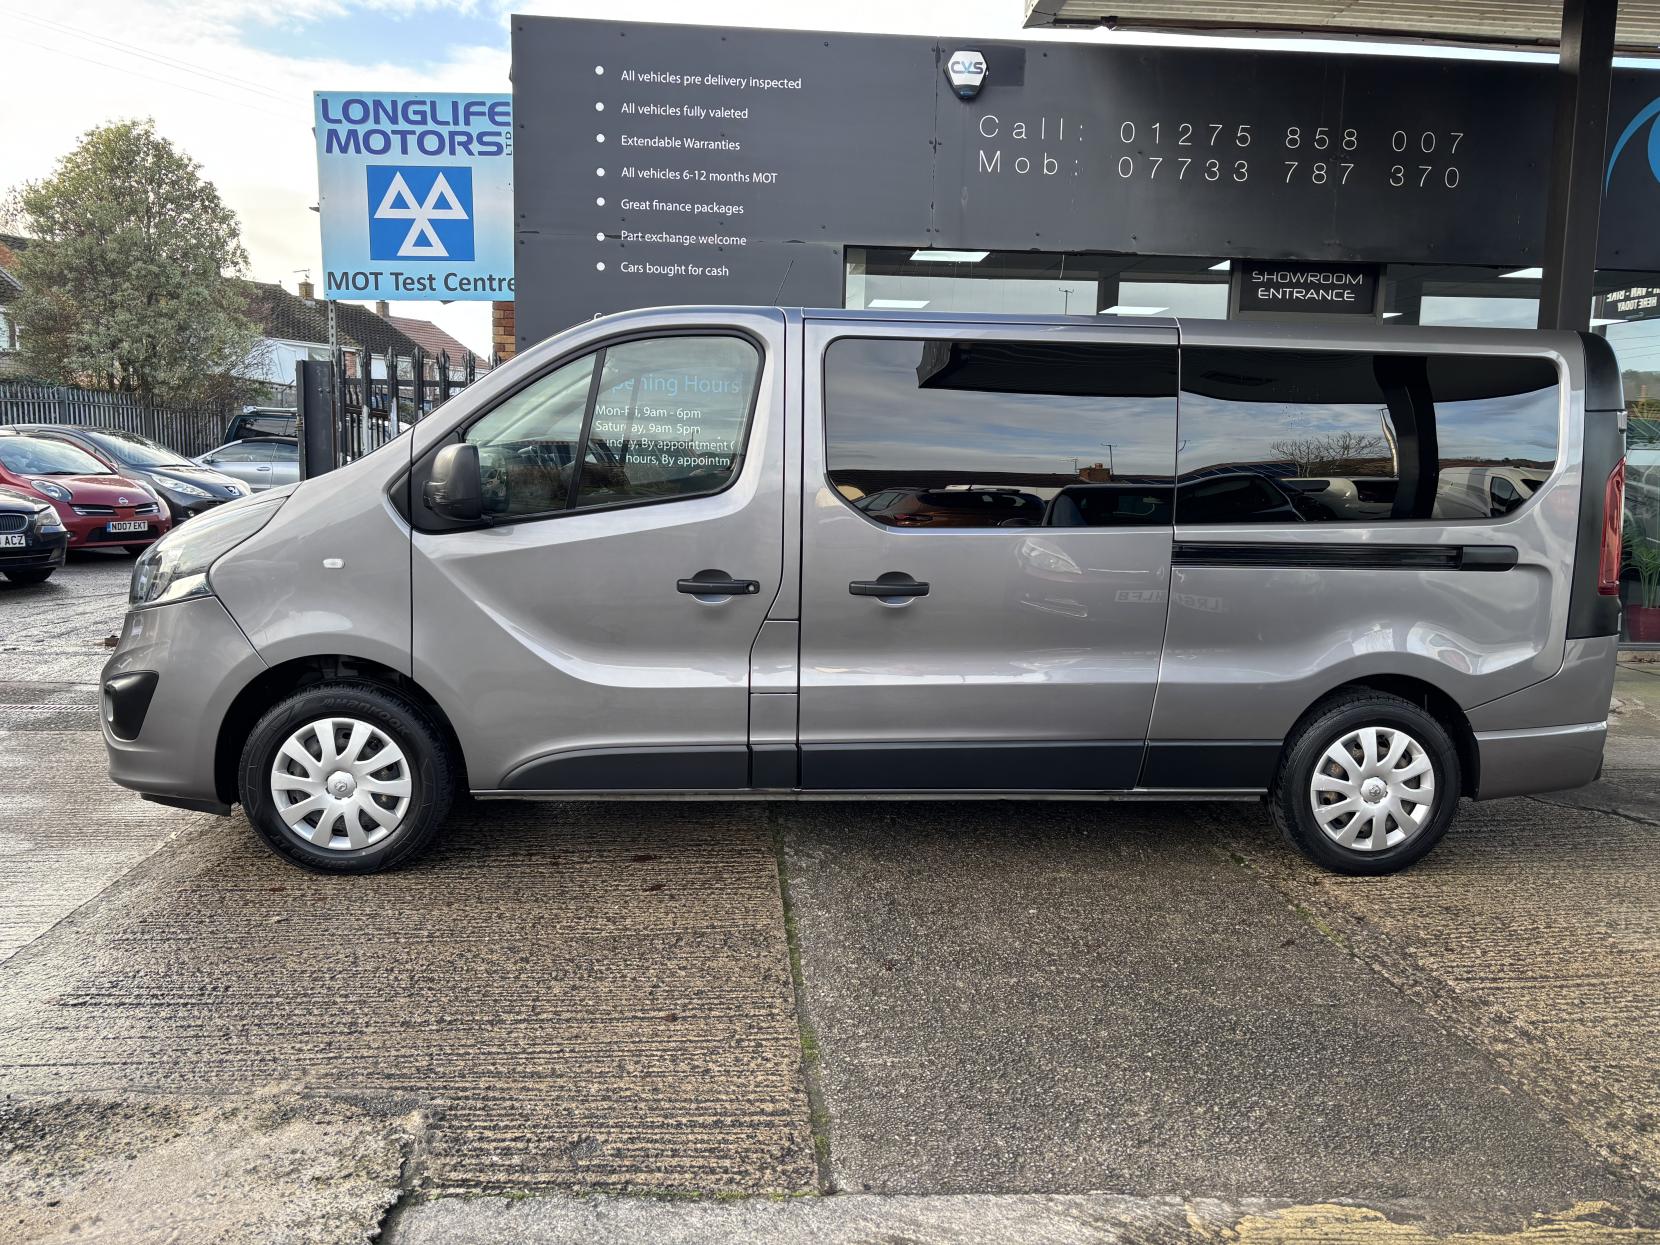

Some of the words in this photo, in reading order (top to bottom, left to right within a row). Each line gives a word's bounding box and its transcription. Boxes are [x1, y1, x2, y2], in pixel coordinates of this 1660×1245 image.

[951, 61, 983, 74] CVS
[621, 70, 635, 81] All
[638, 72, 681, 84] vehicles
[684, 75, 702, 86] pre
[704, 75, 747, 88] delivery
[750, 77, 802, 90] inspected
[321, 98, 512, 127] LONGLIFE
[621, 103, 635, 114] All
[638, 104, 681, 116] vehicles
[683, 105, 706, 119] fully
[709, 107, 748, 119] valeted
[979, 115, 1083, 142] Call:
[1120, 121, 1251, 147] 01275
[1285, 127, 1357, 150] 858
[1392, 131, 1464, 154] 007
[325, 128, 504, 157] MOTORS
[621, 135, 681, 148] Extendable
[683, 137, 741, 150] Warranties
[621, 167, 635, 178] All
[638, 168, 680, 180] vehicles
[683, 170, 707, 181] 6-12
[710, 171, 750, 182] months
[753, 172, 778, 184] MOT
[979, 150, 1078, 176] Mob:
[1118, 157, 1248, 182] 07733
[1284, 161, 1354, 185] 787
[1390, 165, 1460, 188] 370
[621, 199, 650, 210] Great
[652, 200, 692, 212] finance
[694, 201, 744, 216] packages
[621, 230, 643, 241] Part
[645, 231, 696, 246] exchange
[698, 234, 747, 245] welcome
[621, 262, 644, 273] Cars
[647, 263, 685, 277] bought
[688, 264, 703, 275] for
[705, 265, 729, 276] cash
[327, 271, 383, 290] MOT
[390, 272, 436, 291] Test
[444, 273, 514, 292] Centre
[1252, 271, 1363, 285] SHOWROOM
[1258, 288, 1355, 301] ENTRANCE
[609, 374, 678, 396] pening
[685, 375, 740, 393] Hours
[596, 405, 640, 417] Mon-Fi,
[643, 407, 667, 417] 9am
[676, 408, 701, 419] 6pm
[595, 421, 646, 434] Saturay,
[648, 423, 672, 433] 9am
[676, 424, 701, 435] 5pm
[641, 437, 655, 449] By
[657, 439, 728, 452] appointment
[661, 454, 674, 466] By
[677, 456, 730, 467] appointm
[133, 522, 147, 530] EKT
[4, 535, 24, 546] ACZ
